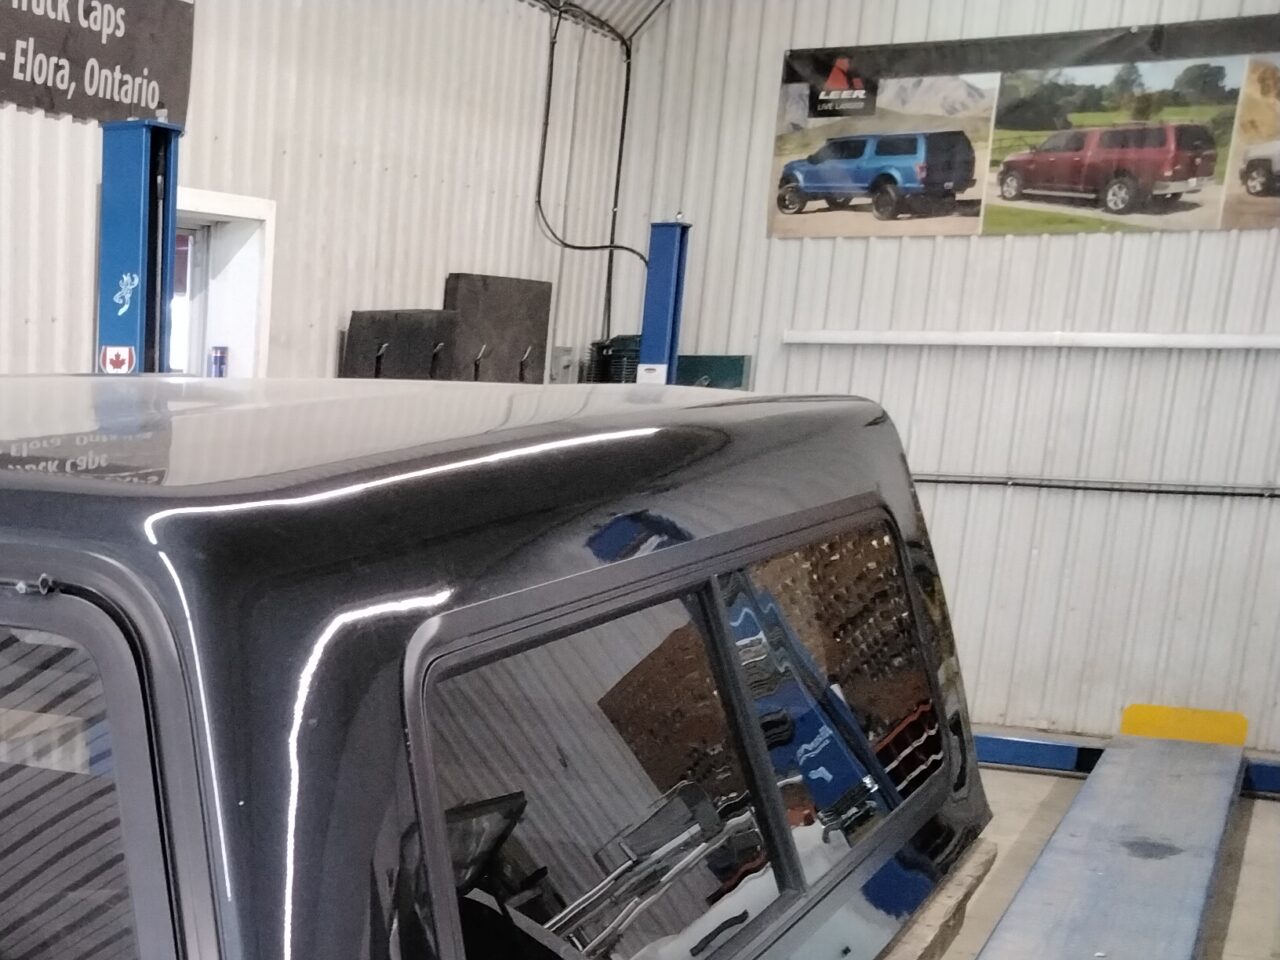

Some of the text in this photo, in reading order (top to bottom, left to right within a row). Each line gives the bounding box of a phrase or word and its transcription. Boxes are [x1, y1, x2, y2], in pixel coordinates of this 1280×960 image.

[11, 0, 125, 44] uck Caps
[12, 37, 77, 100] Elora,
[84, 57, 160, 110] Ontario
[818, 89, 867, 100] LEER
